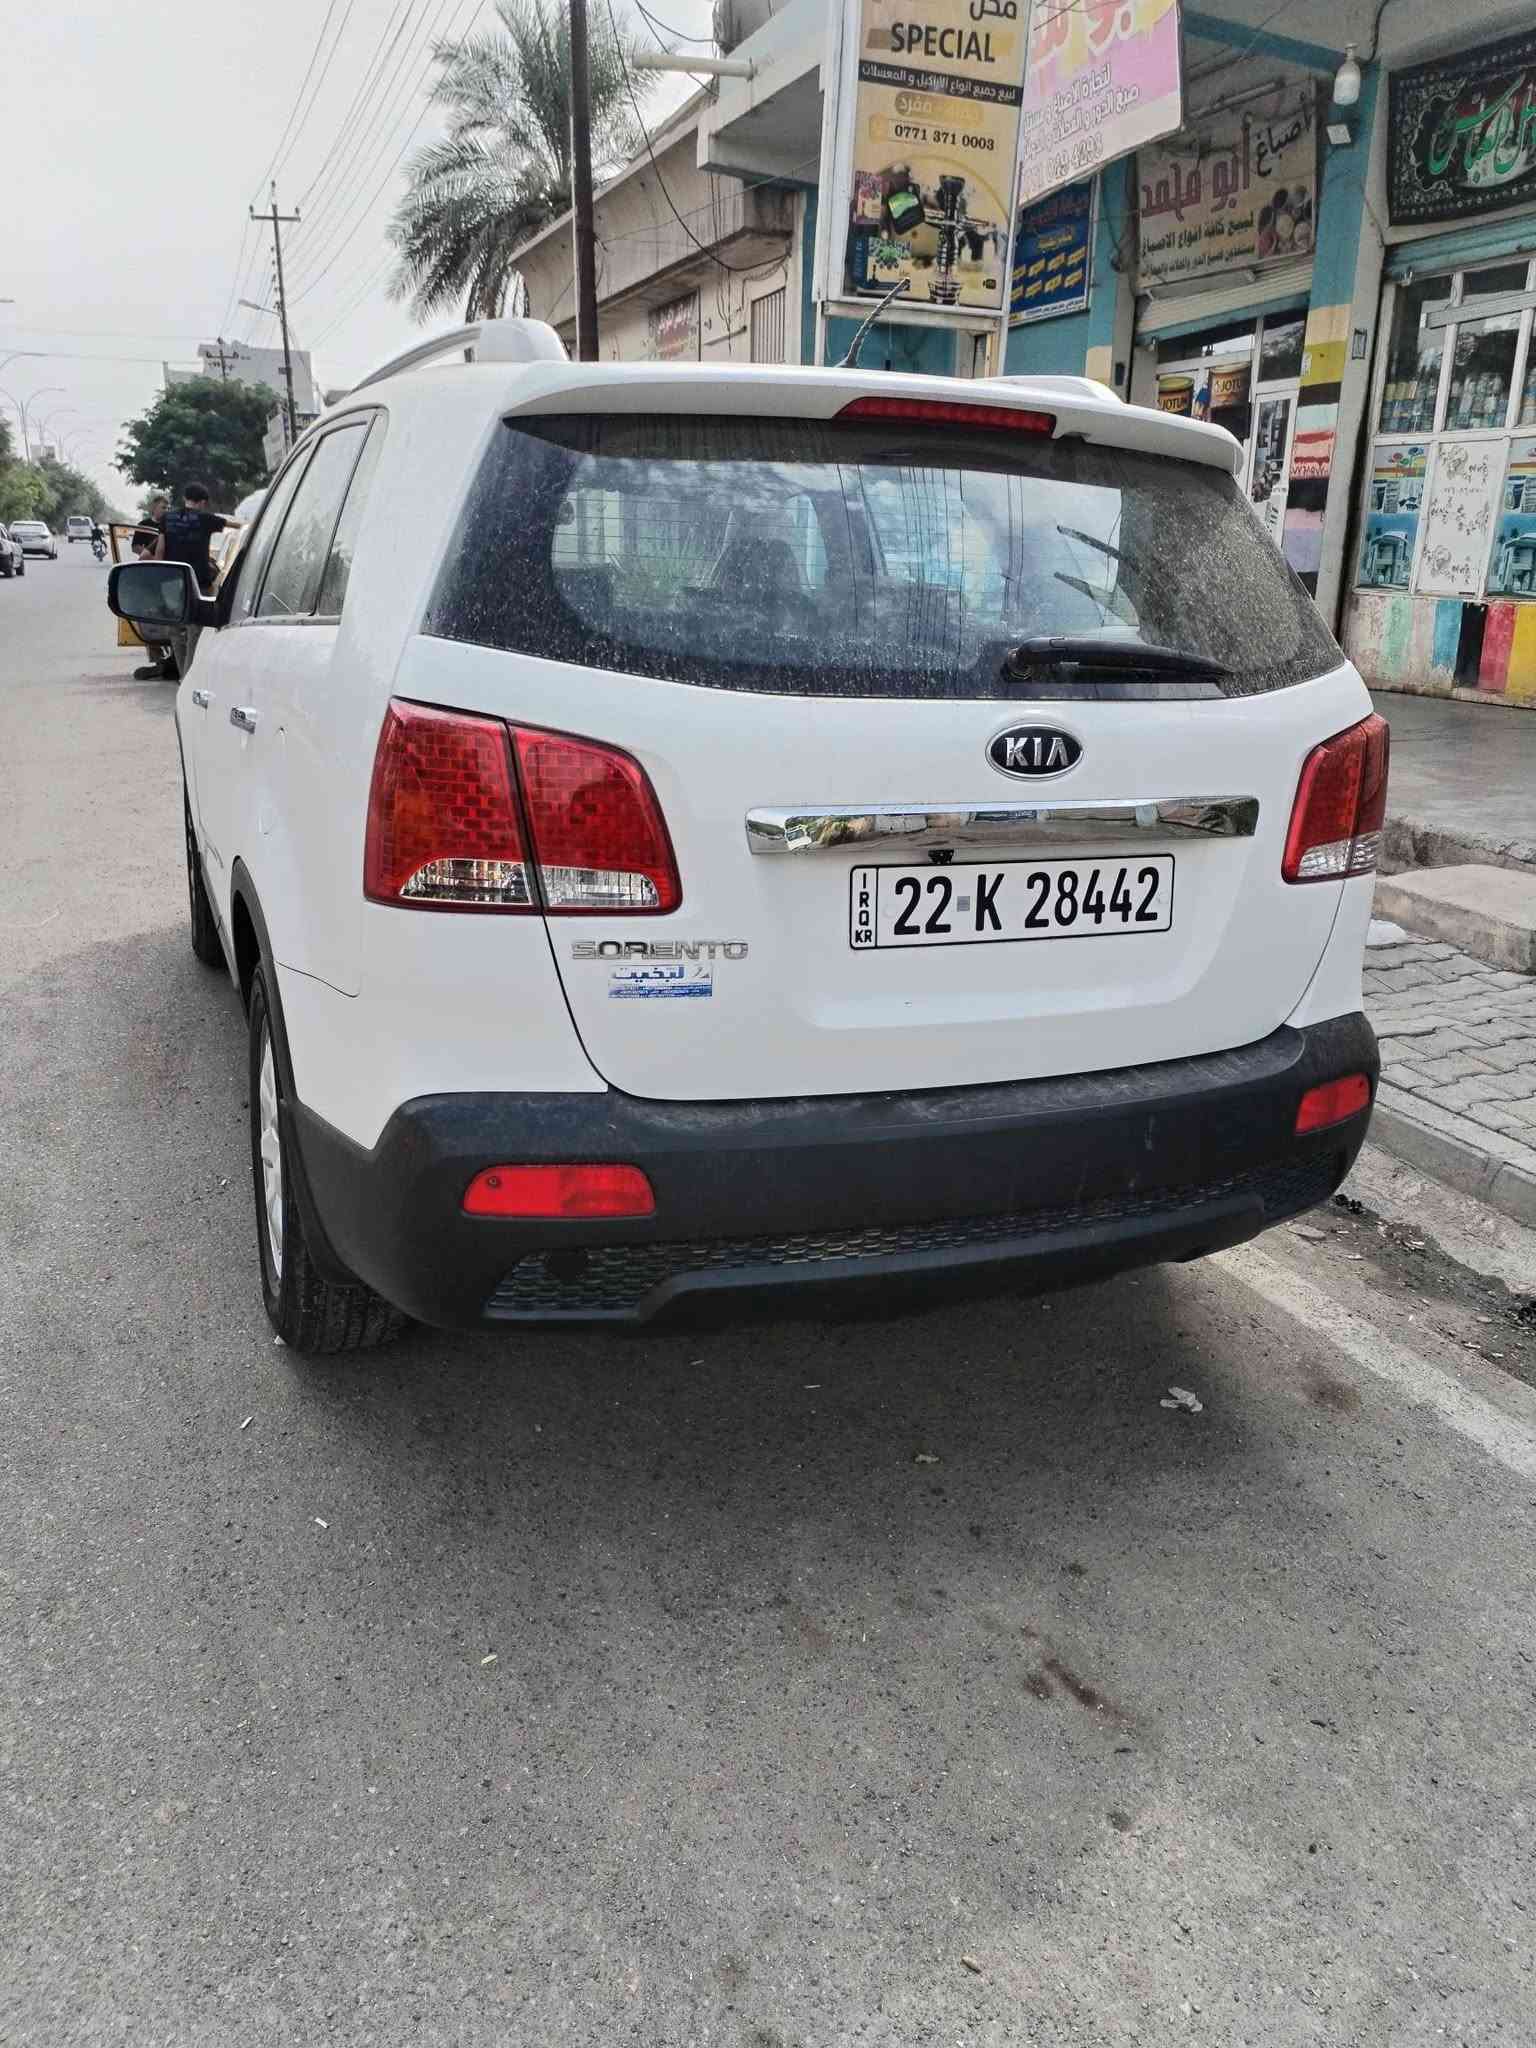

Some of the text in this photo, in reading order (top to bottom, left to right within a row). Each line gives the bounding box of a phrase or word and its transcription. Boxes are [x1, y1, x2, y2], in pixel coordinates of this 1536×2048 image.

[891, 22, 995, 62] SPECIAL
[973, 85, 996, 98] جميع
[894, 124, 994, 151] 0771 371 0003
[1005, 737, 1069, 767] KIA
[894, 867, 1160, 935] 22 K 28442
[572, 940, 748, 960] SORENTO
[855, 930, 872, 943] KR
